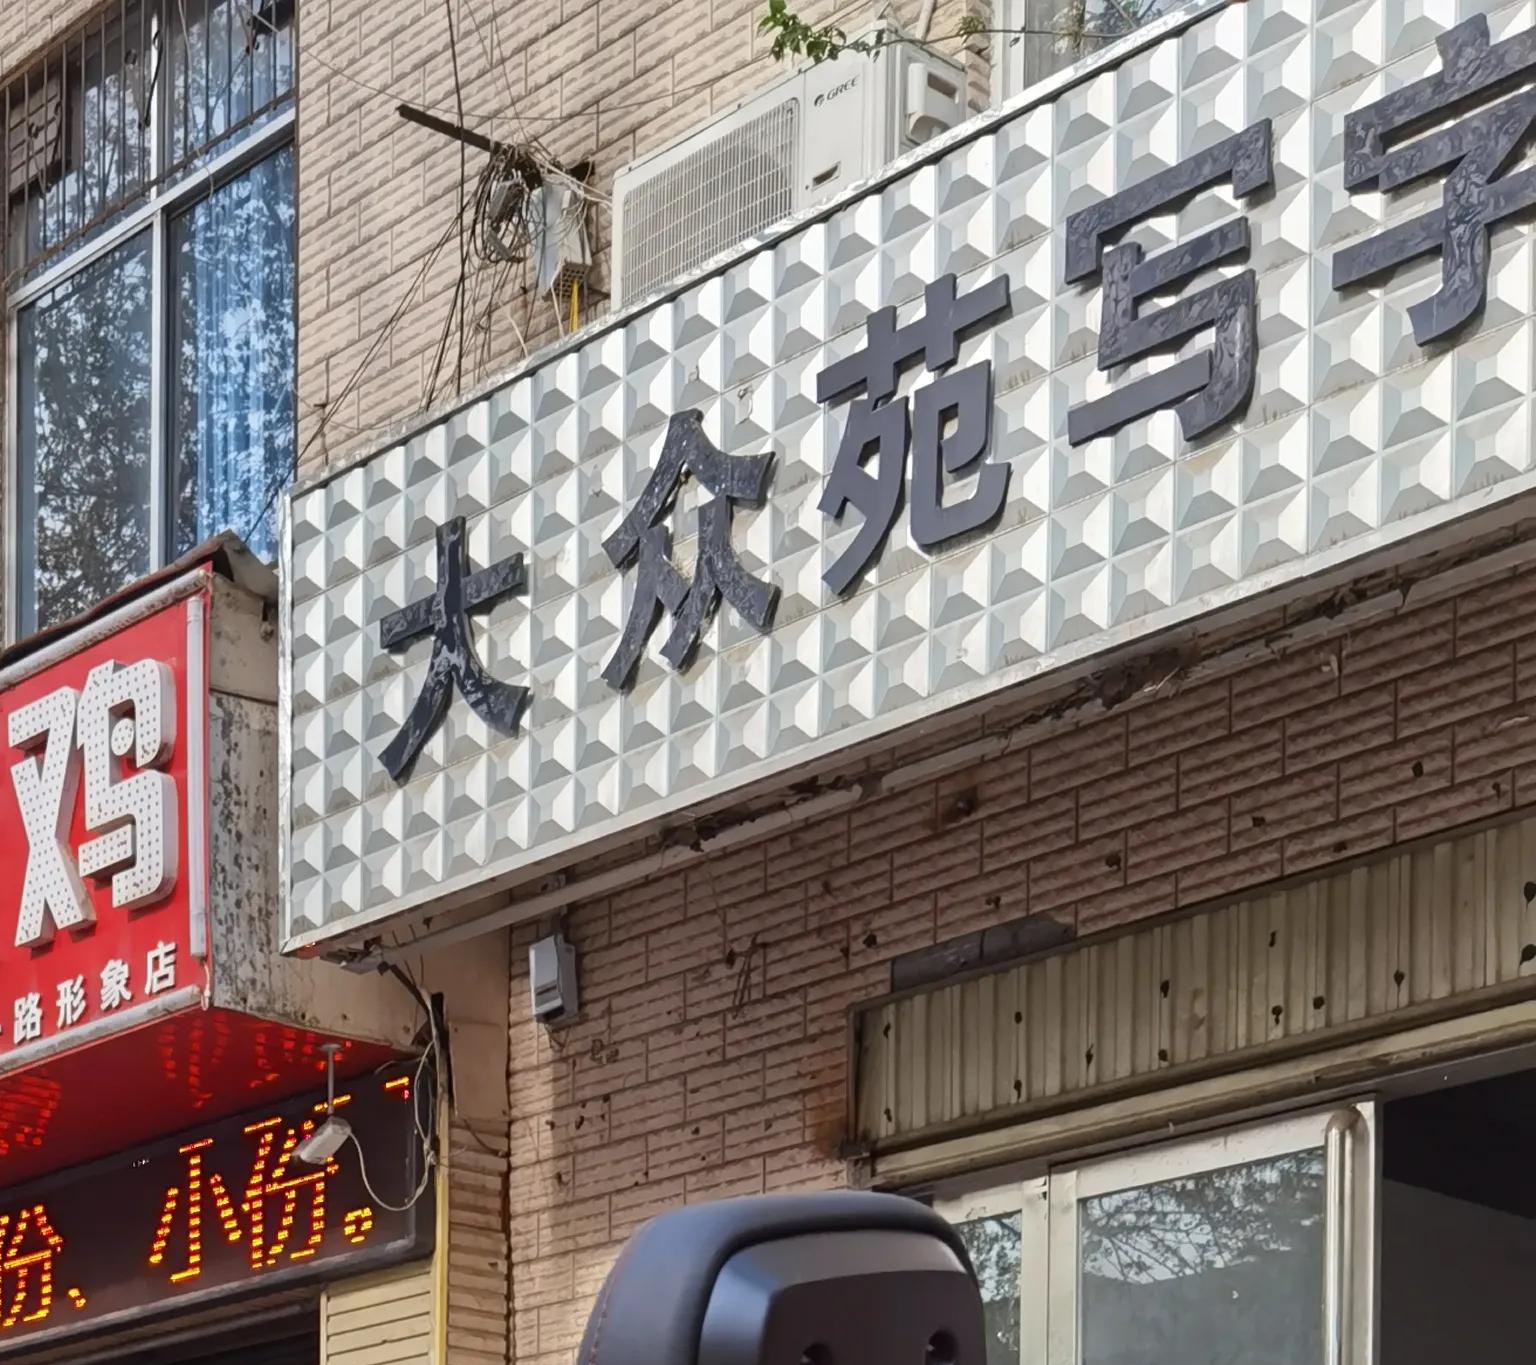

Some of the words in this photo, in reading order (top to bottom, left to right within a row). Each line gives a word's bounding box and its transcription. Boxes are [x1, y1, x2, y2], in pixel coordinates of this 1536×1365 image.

[377, 12, 1536, 782] 大众苑写字
